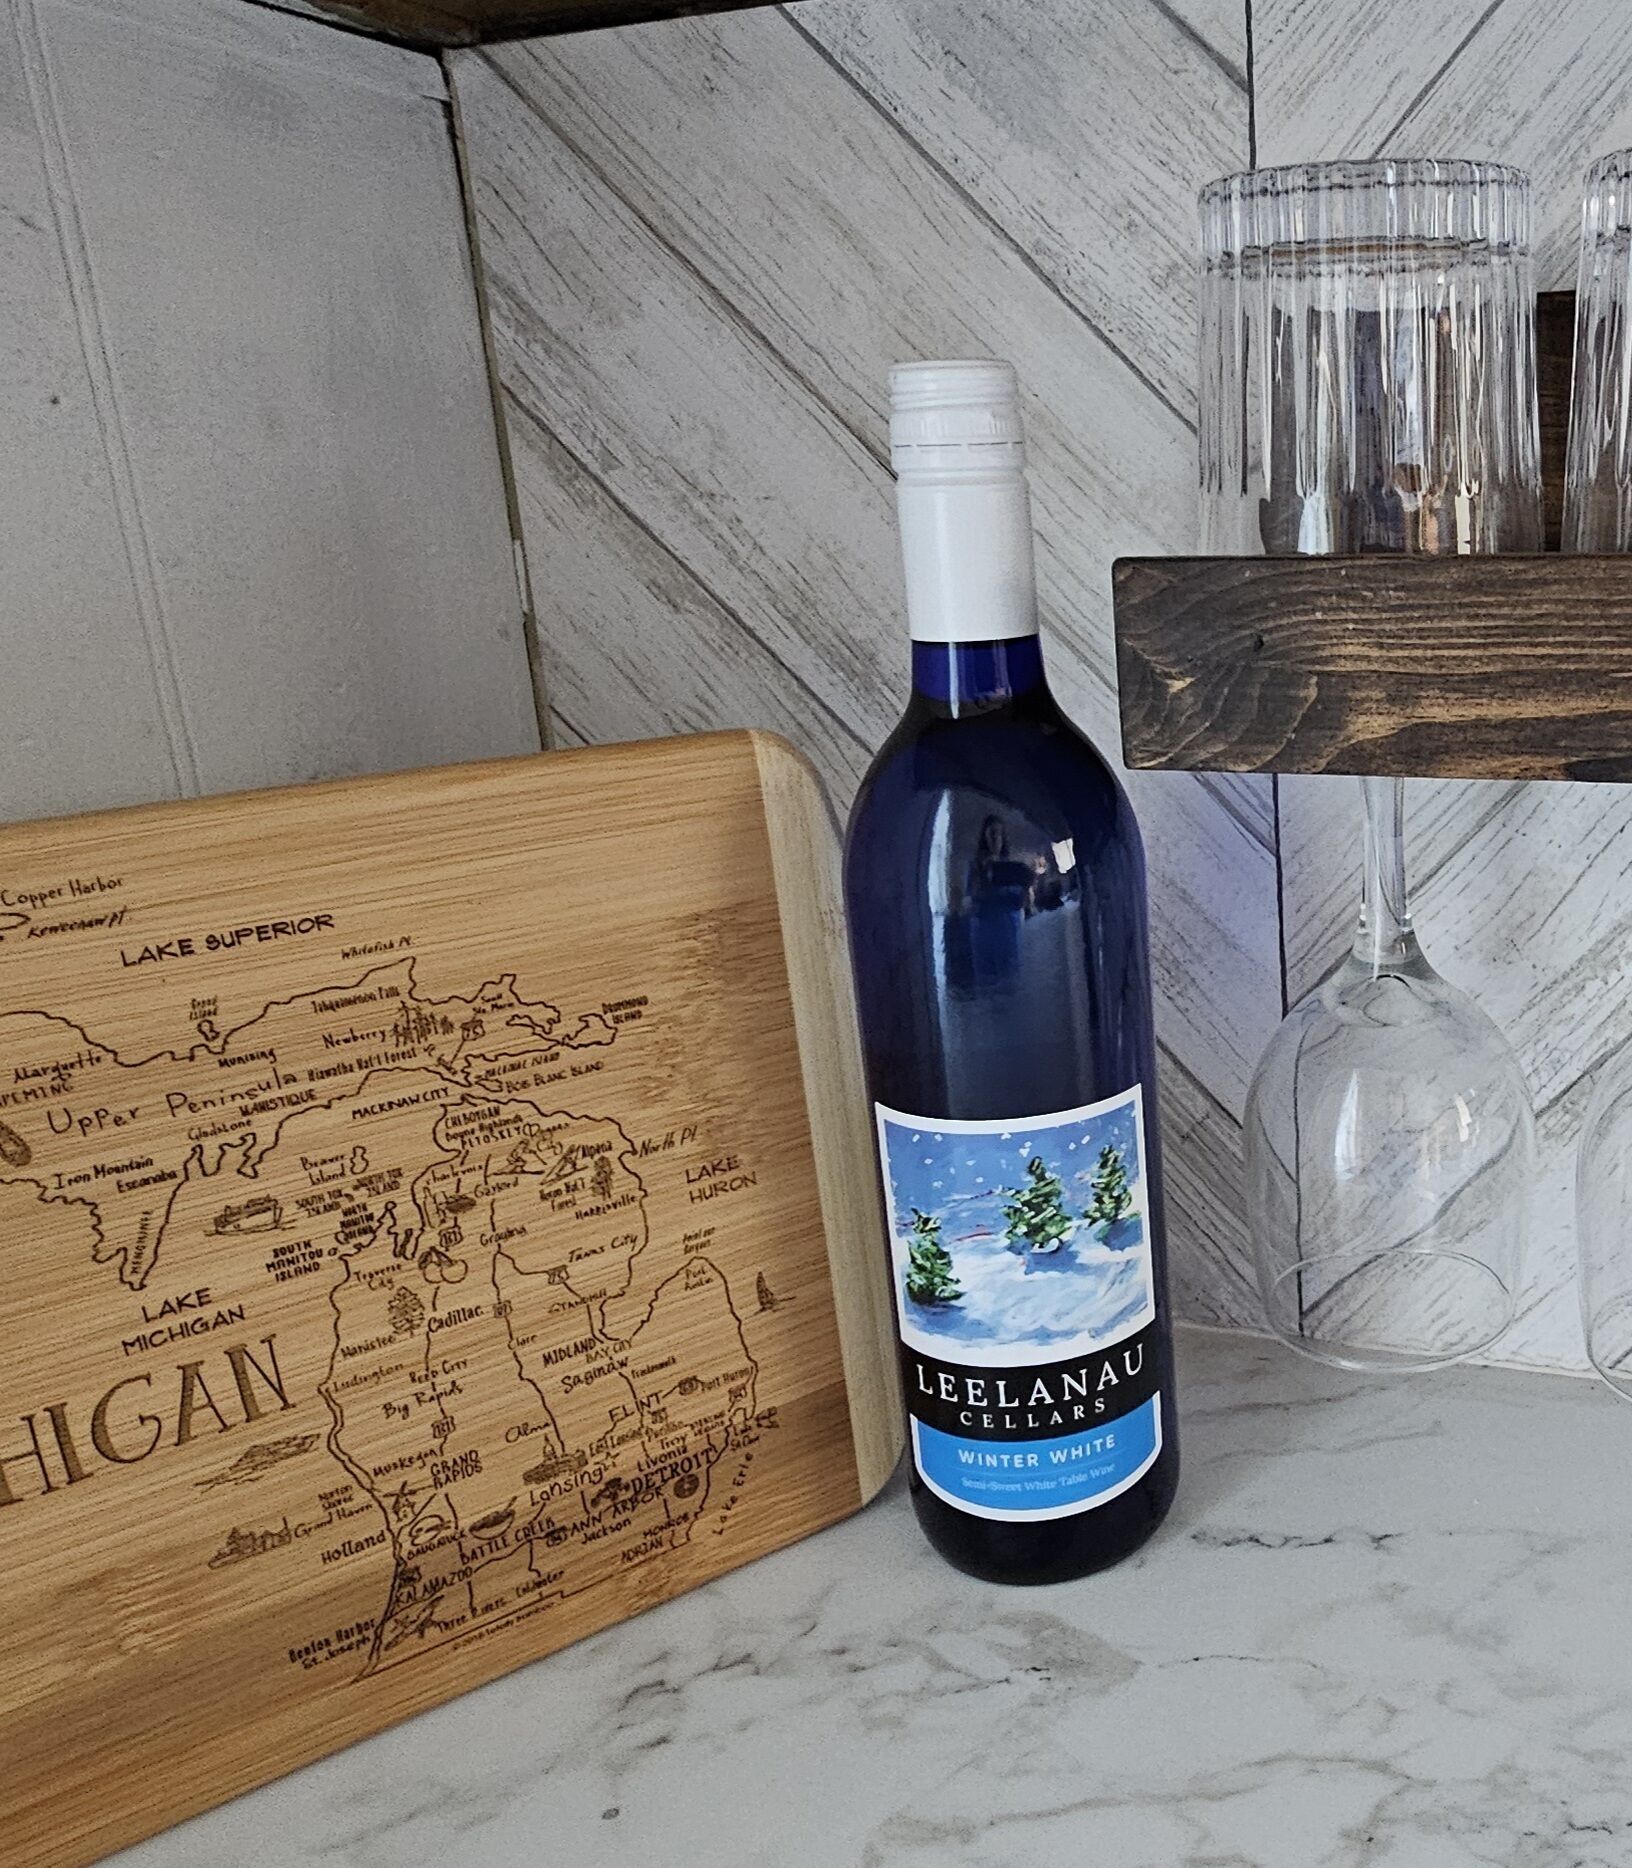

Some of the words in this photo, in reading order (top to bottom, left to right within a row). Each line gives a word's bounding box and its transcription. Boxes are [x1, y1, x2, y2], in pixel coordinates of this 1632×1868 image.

[1, 887, 63, 909] Copper
[68, 876, 124, 896] Harbor
[121, 938, 196, 967] LAKE
[205, 914, 335, 950] SUPERIOR
[322, 1028, 386, 1049] Newberry
[47, 1106, 140, 1137] Upper
[166, 1067, 298, 1118] Peninsula
[639, 1132, 675, 1158] North
[52, 1172, 90, 1191] Iron
[93, 1156, 154, 1179] Mountain
[116, 1169, 178, 1194] Escanaba
[685, 1154, 741, 1184] LAKE
[689, 1171, 758, 1204] HURON
[265, 1248, 323, 1273] MANITOU
[272, 1240, 313, 1258] SOUTH
[275, 1261, 321, 1283] ISLAND
[141, 1287, 213, 1323] LAKE
[428, 1305, 482, 1333] Cadillac
[121, 1304, 246, 1356] MICHIGAN
[542, 1338, 596, 1368] MIDLAND
[561, 1356, 629, 1394] Saginaw
[916, 1343, 1144, 1408] LEELANAU
[382, 1402, 410, 1421] Big
[960, 1397, 1106, 1429] CELLARS
[430, 1450, 481, 1477] GRAND
[958, 1448, 1040, 1469] WINTER
[1049, 1434, 1116, 1465] WHITE
[433, 1463, 483, 1491] RAPIDS
[631, 1447, 716, 1494] DETROIT
[961, 1476, 1022, 1492] Semi-Sweet
[1024, 1478, 1057, 1492] White
[1061, 1472, 1089, 1487] Table
[1090, 1463, 1116, 1479] Wine
[530, 1466, 603, 1507] Lansing
[571, 1511, 602, 1537] ANN
[581, 1518, 631, 1545] Jackson
[320, 1530, 387, 1564] Holland
[460, 1538, 509, 1565] BATTLE
[336, 1618, 375, 1642] Harbor
